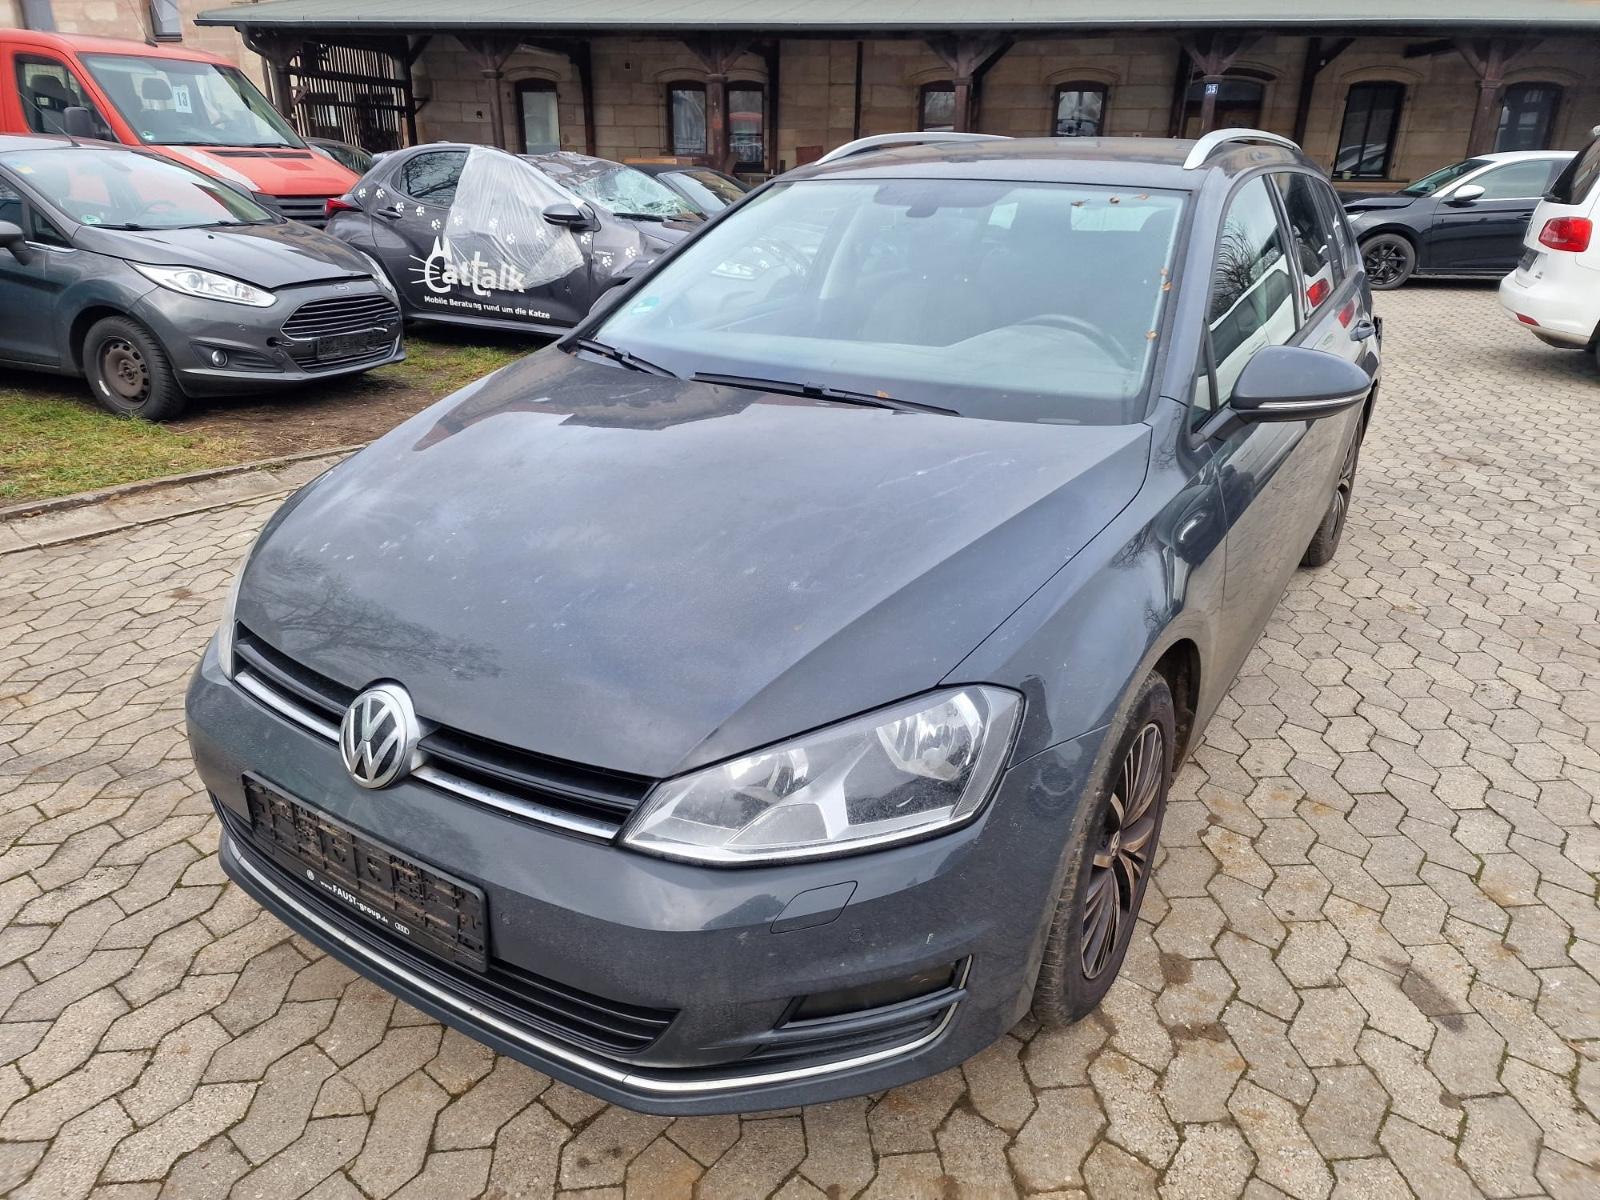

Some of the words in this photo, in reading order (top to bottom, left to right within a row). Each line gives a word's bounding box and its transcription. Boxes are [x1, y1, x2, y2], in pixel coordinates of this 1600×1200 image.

[424, 295, 448, 305] Mobile
[449, 299, 482, 310] Beratung
[483, 304, 500, 312] rund
[501, 306, 514, 314] um
[515, 307, 527, 315] die
[528, 308, 550, 319] Katze
